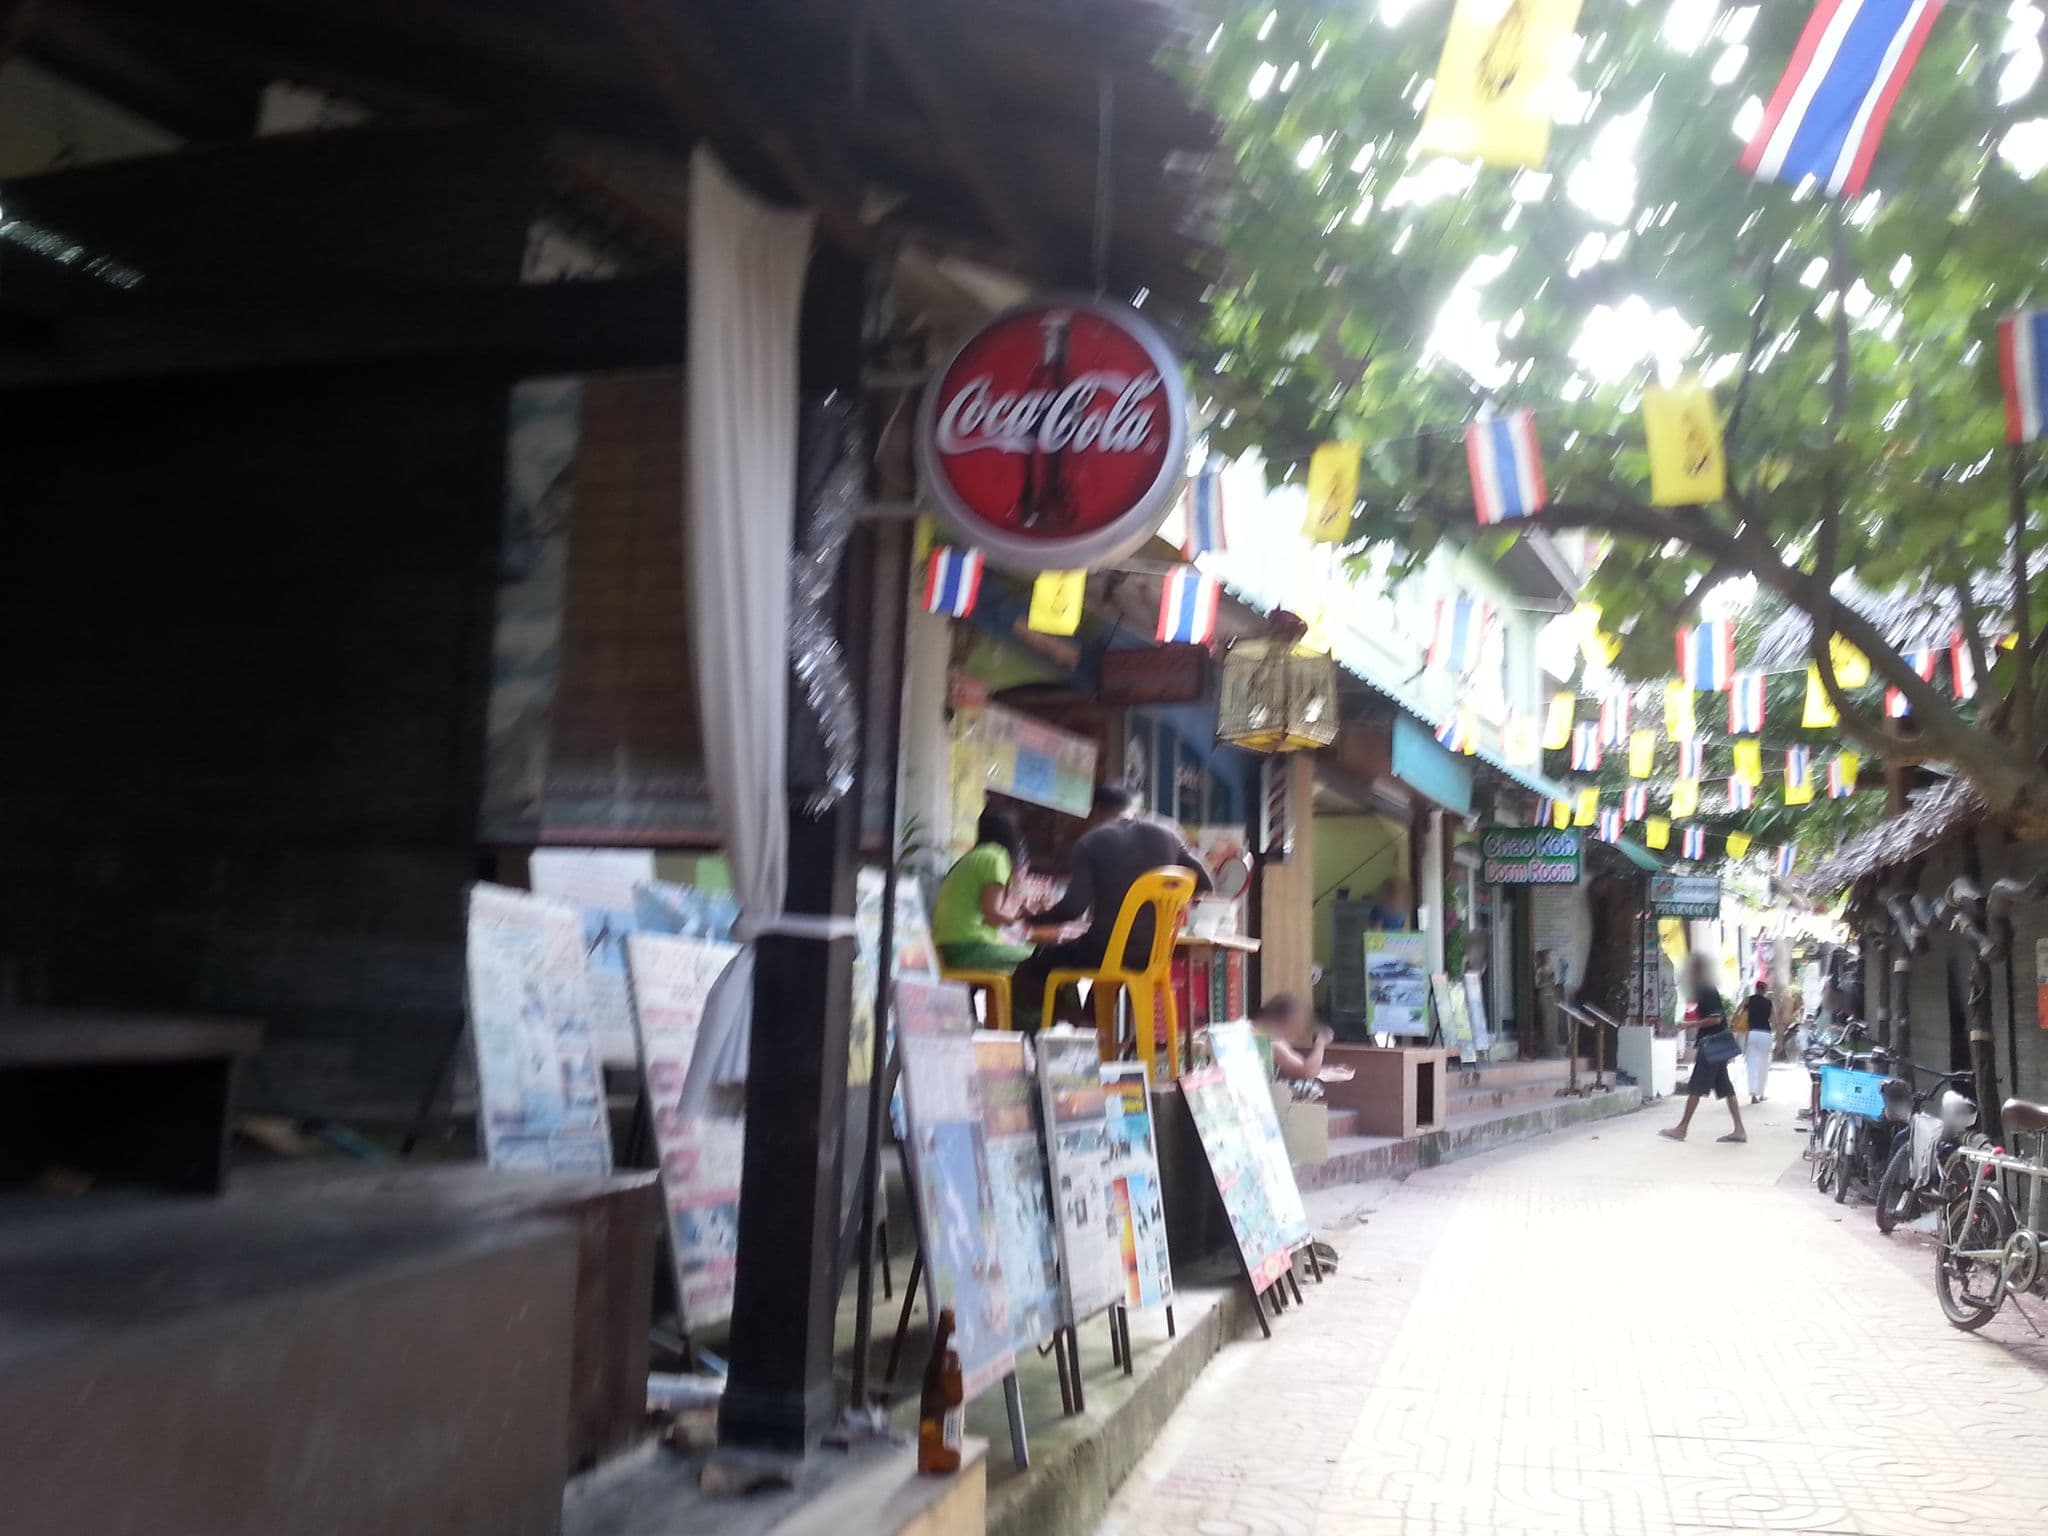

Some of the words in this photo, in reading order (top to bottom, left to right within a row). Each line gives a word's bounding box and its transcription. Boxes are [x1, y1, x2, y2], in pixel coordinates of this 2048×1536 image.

[1536, 832, 1578, 856] Koh
[1528, 859, 1577, 882] Room
[1655, 903, 1716, 915] PHARMACY
